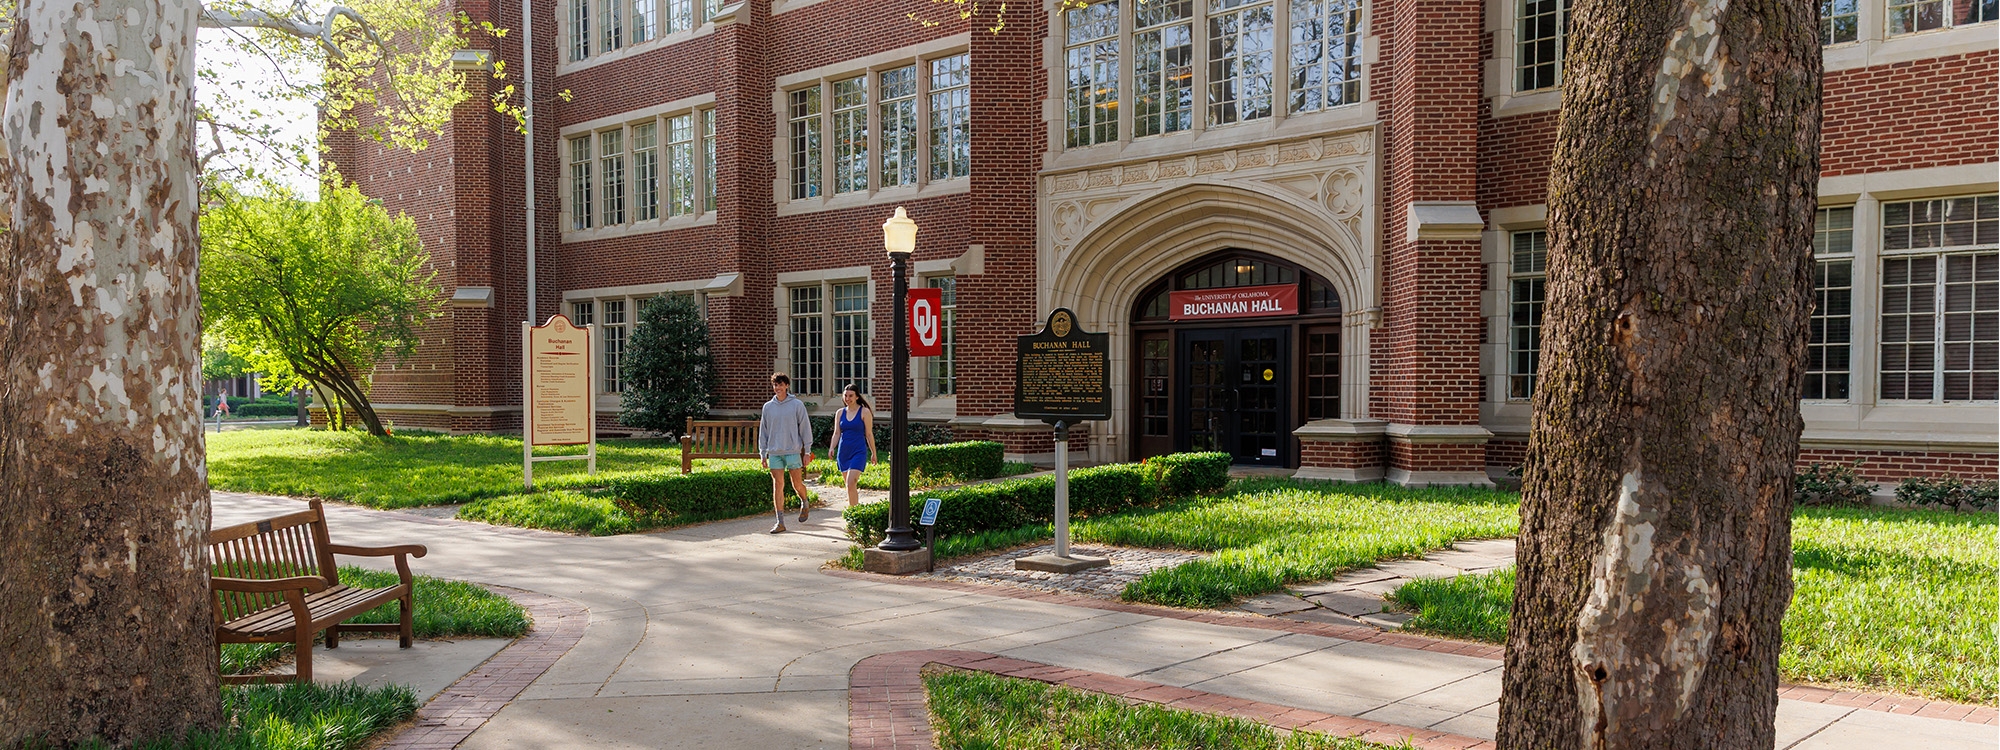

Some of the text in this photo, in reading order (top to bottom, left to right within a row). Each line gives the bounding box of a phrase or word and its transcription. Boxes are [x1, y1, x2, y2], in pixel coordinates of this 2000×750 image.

[1202, 293, 1231, 301] UNIVERSITY
[1232, 292, 1237, 300] of
[1238, 291, 1269, 299] OKLAHOMA
[1183, 299, 1282, 315] BUCHANAN HALL
[913, 299, 937, 346] OU
[1033, 341, 1067, 349] BUCHANAN
